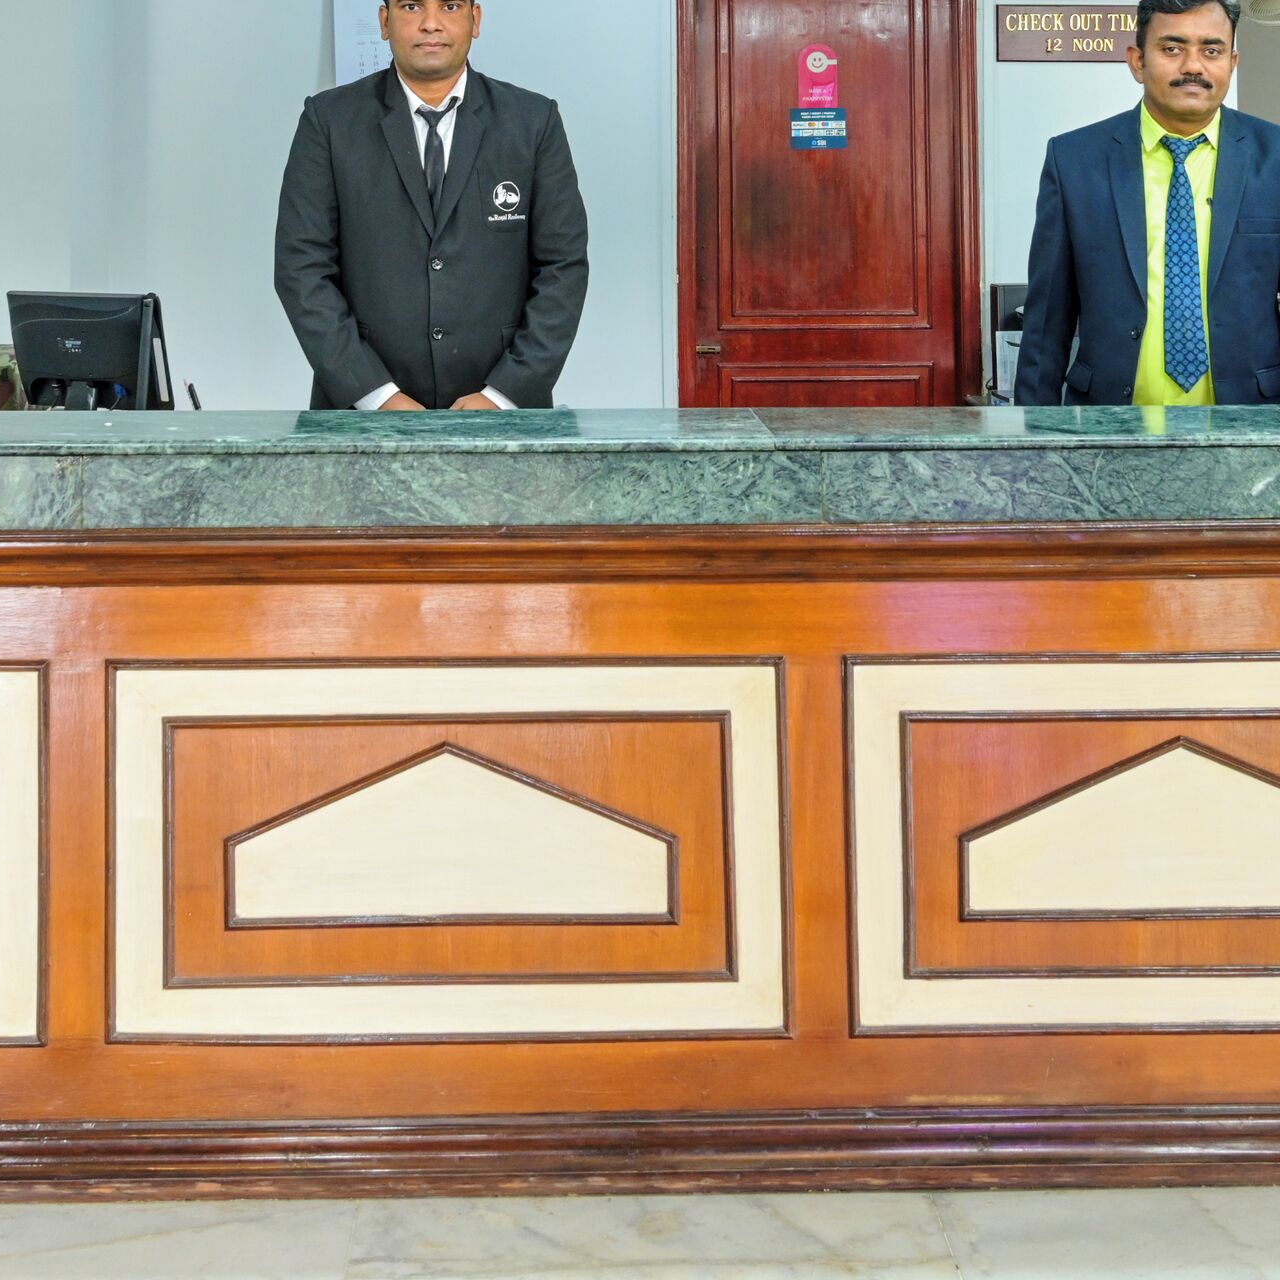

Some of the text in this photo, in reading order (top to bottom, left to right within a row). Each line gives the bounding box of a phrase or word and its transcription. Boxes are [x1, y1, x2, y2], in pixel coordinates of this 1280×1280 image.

[1005, 13, 1138, 32] CHECK OUT TIM
[1046, 38, 1114, 52] 12 NOON
